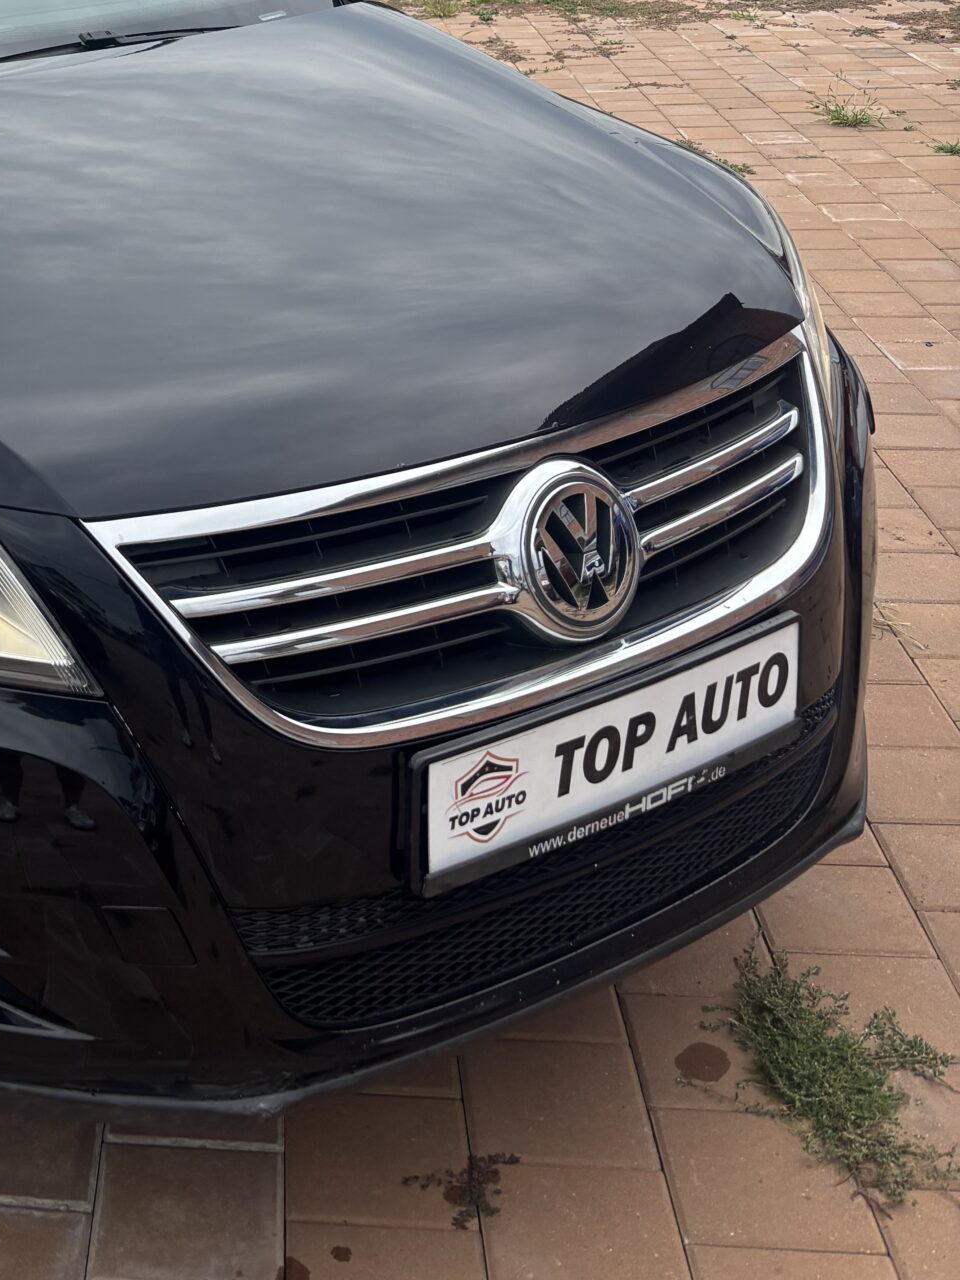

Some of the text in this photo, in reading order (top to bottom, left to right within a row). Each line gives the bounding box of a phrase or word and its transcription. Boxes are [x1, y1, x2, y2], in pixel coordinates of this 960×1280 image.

[554, 651, 790, 798] TOP AUTO
[448, 789, 527, 831] TOP AUTO
